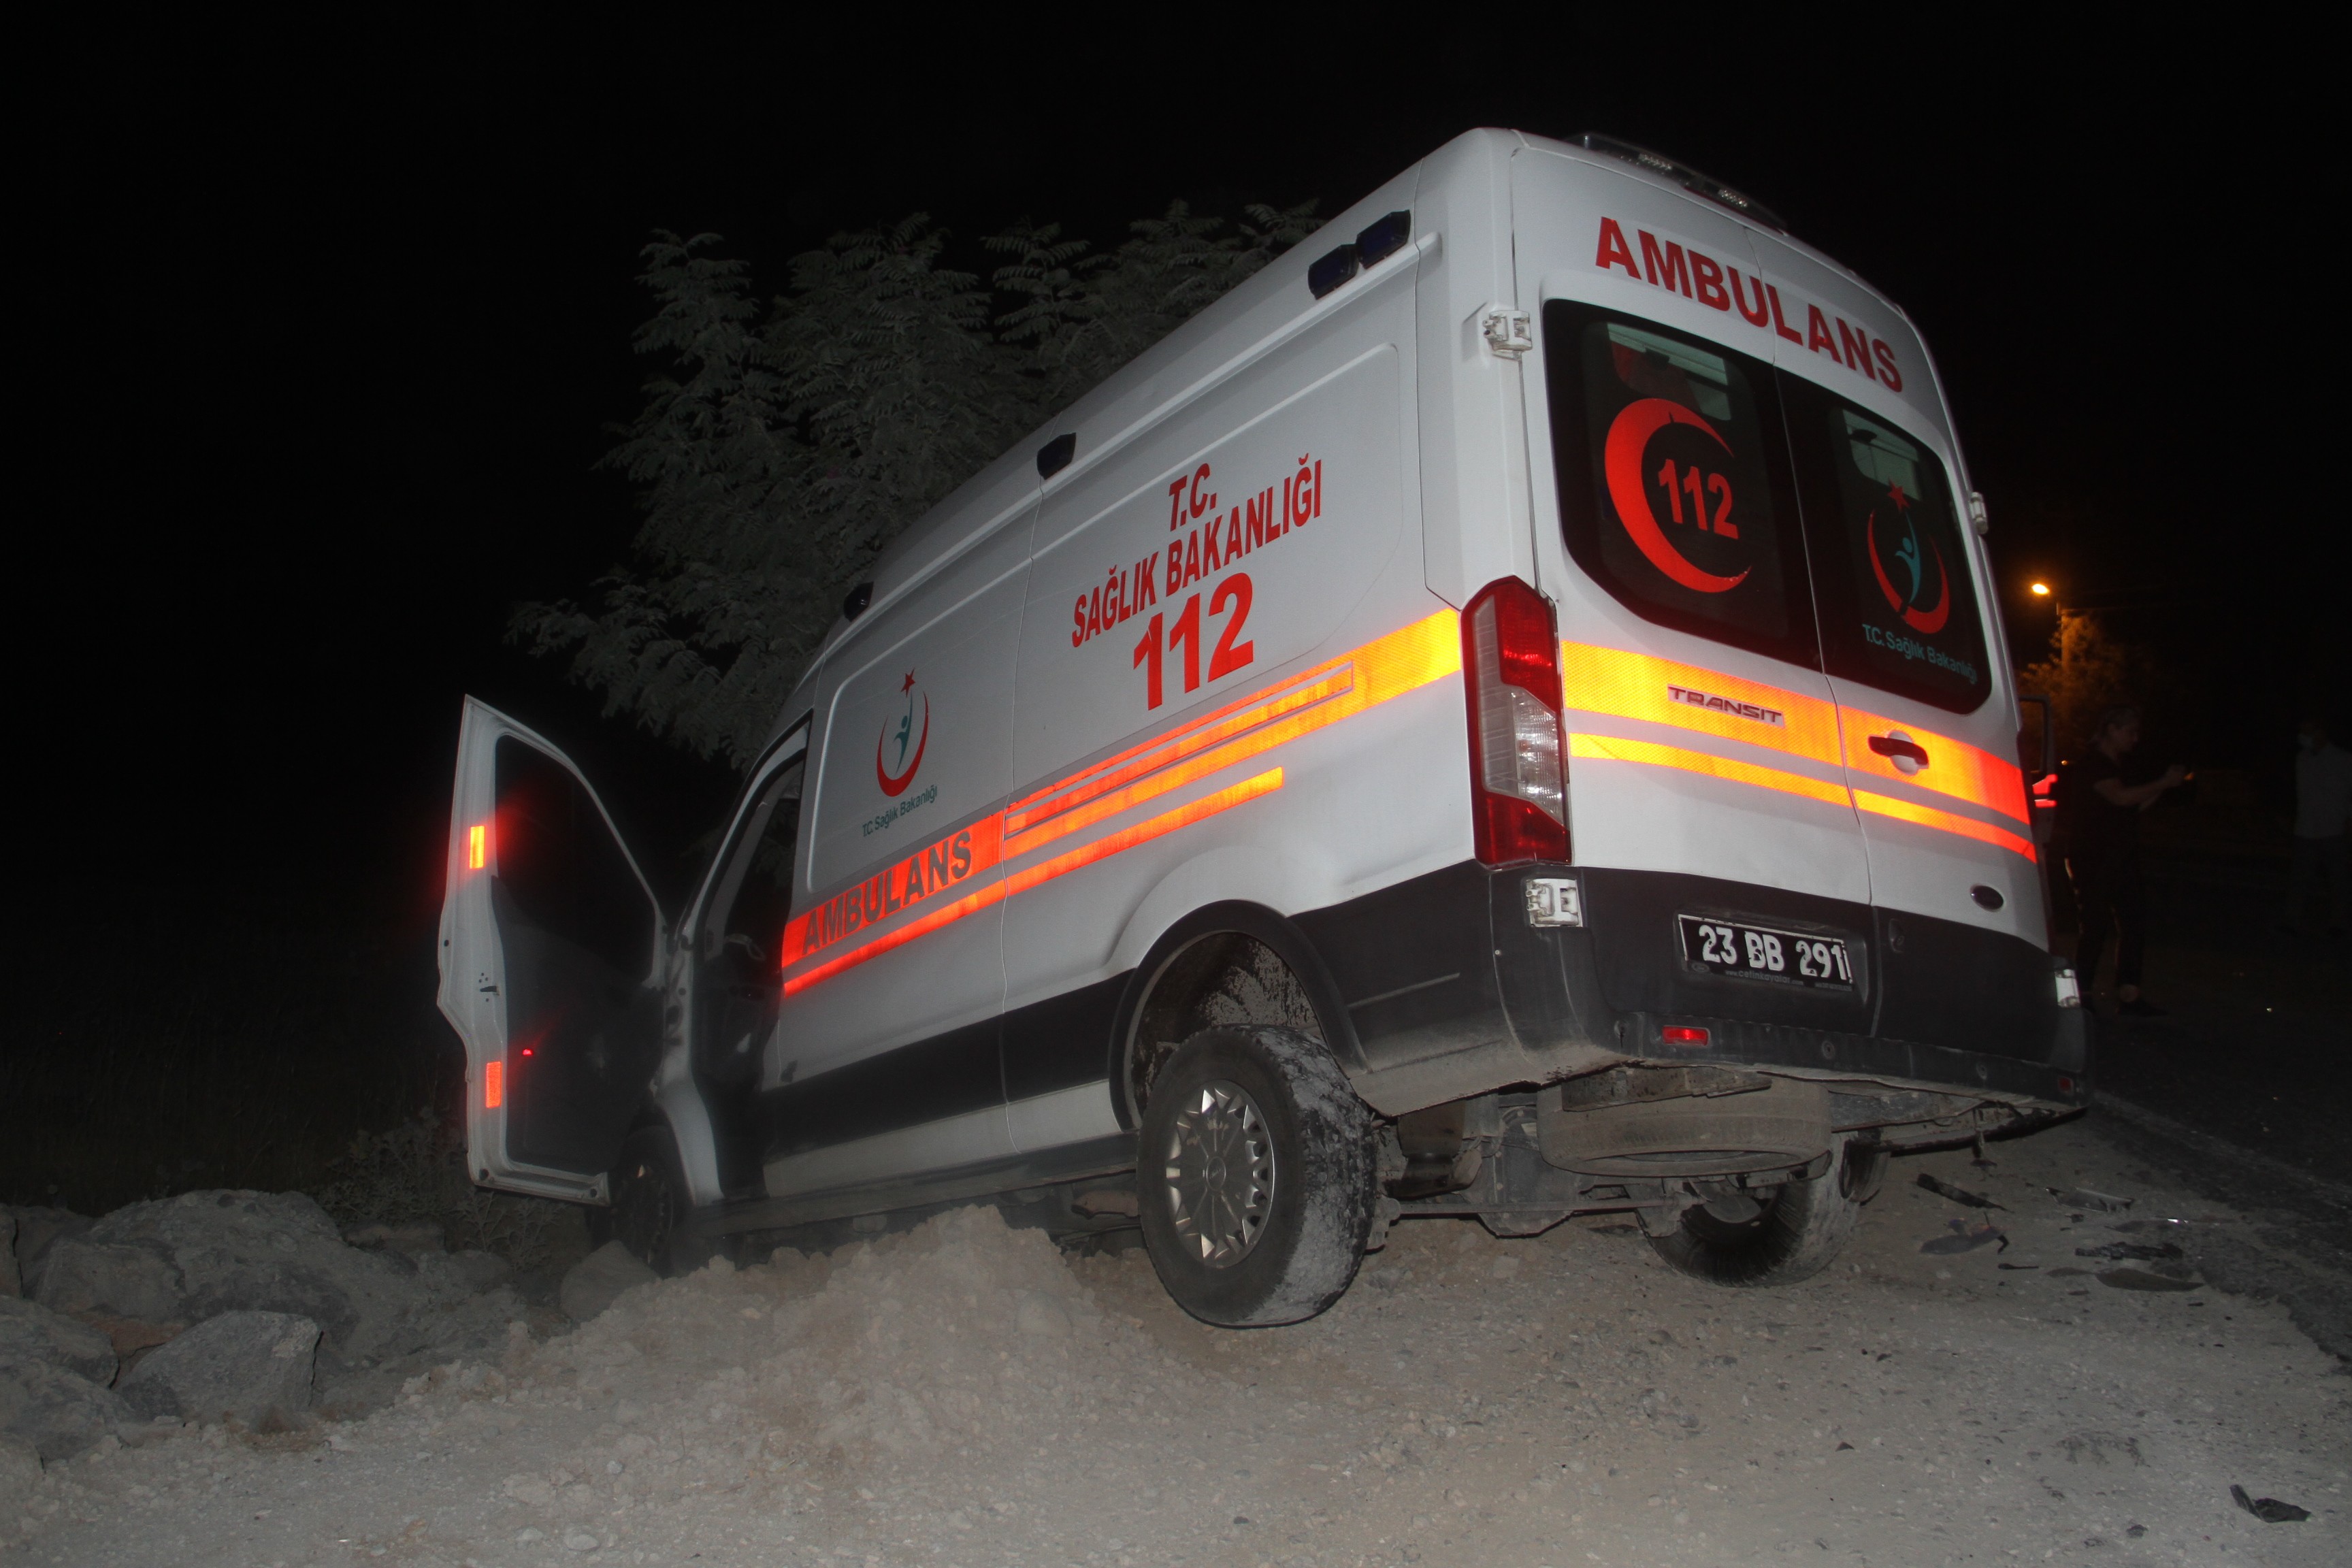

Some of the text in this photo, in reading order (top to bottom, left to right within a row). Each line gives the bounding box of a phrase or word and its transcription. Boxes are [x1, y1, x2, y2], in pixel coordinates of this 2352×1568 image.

[1596, 216, 1902, 393] AMBULANS
[1169, 463, 1217, 532] T.C.
[1658, 459, 1740, 539] 112
[1072, 453, 1322, 647] SAĞLIK BAKANLIĞI
[1134, 572, 1254, 710] 112
[1862, 623, 1978, 685] T.C. Sağlık Bakanlığı
[1668, 687, 1782, 723] TRANSIT
[875, 807, 898, 829] Sağlık
[900, 785, 938, 816] Bakanlığı
[803, 831, 972, 953] AMBULANS
[1699, 924, 1847, 981] 23 BB 291
